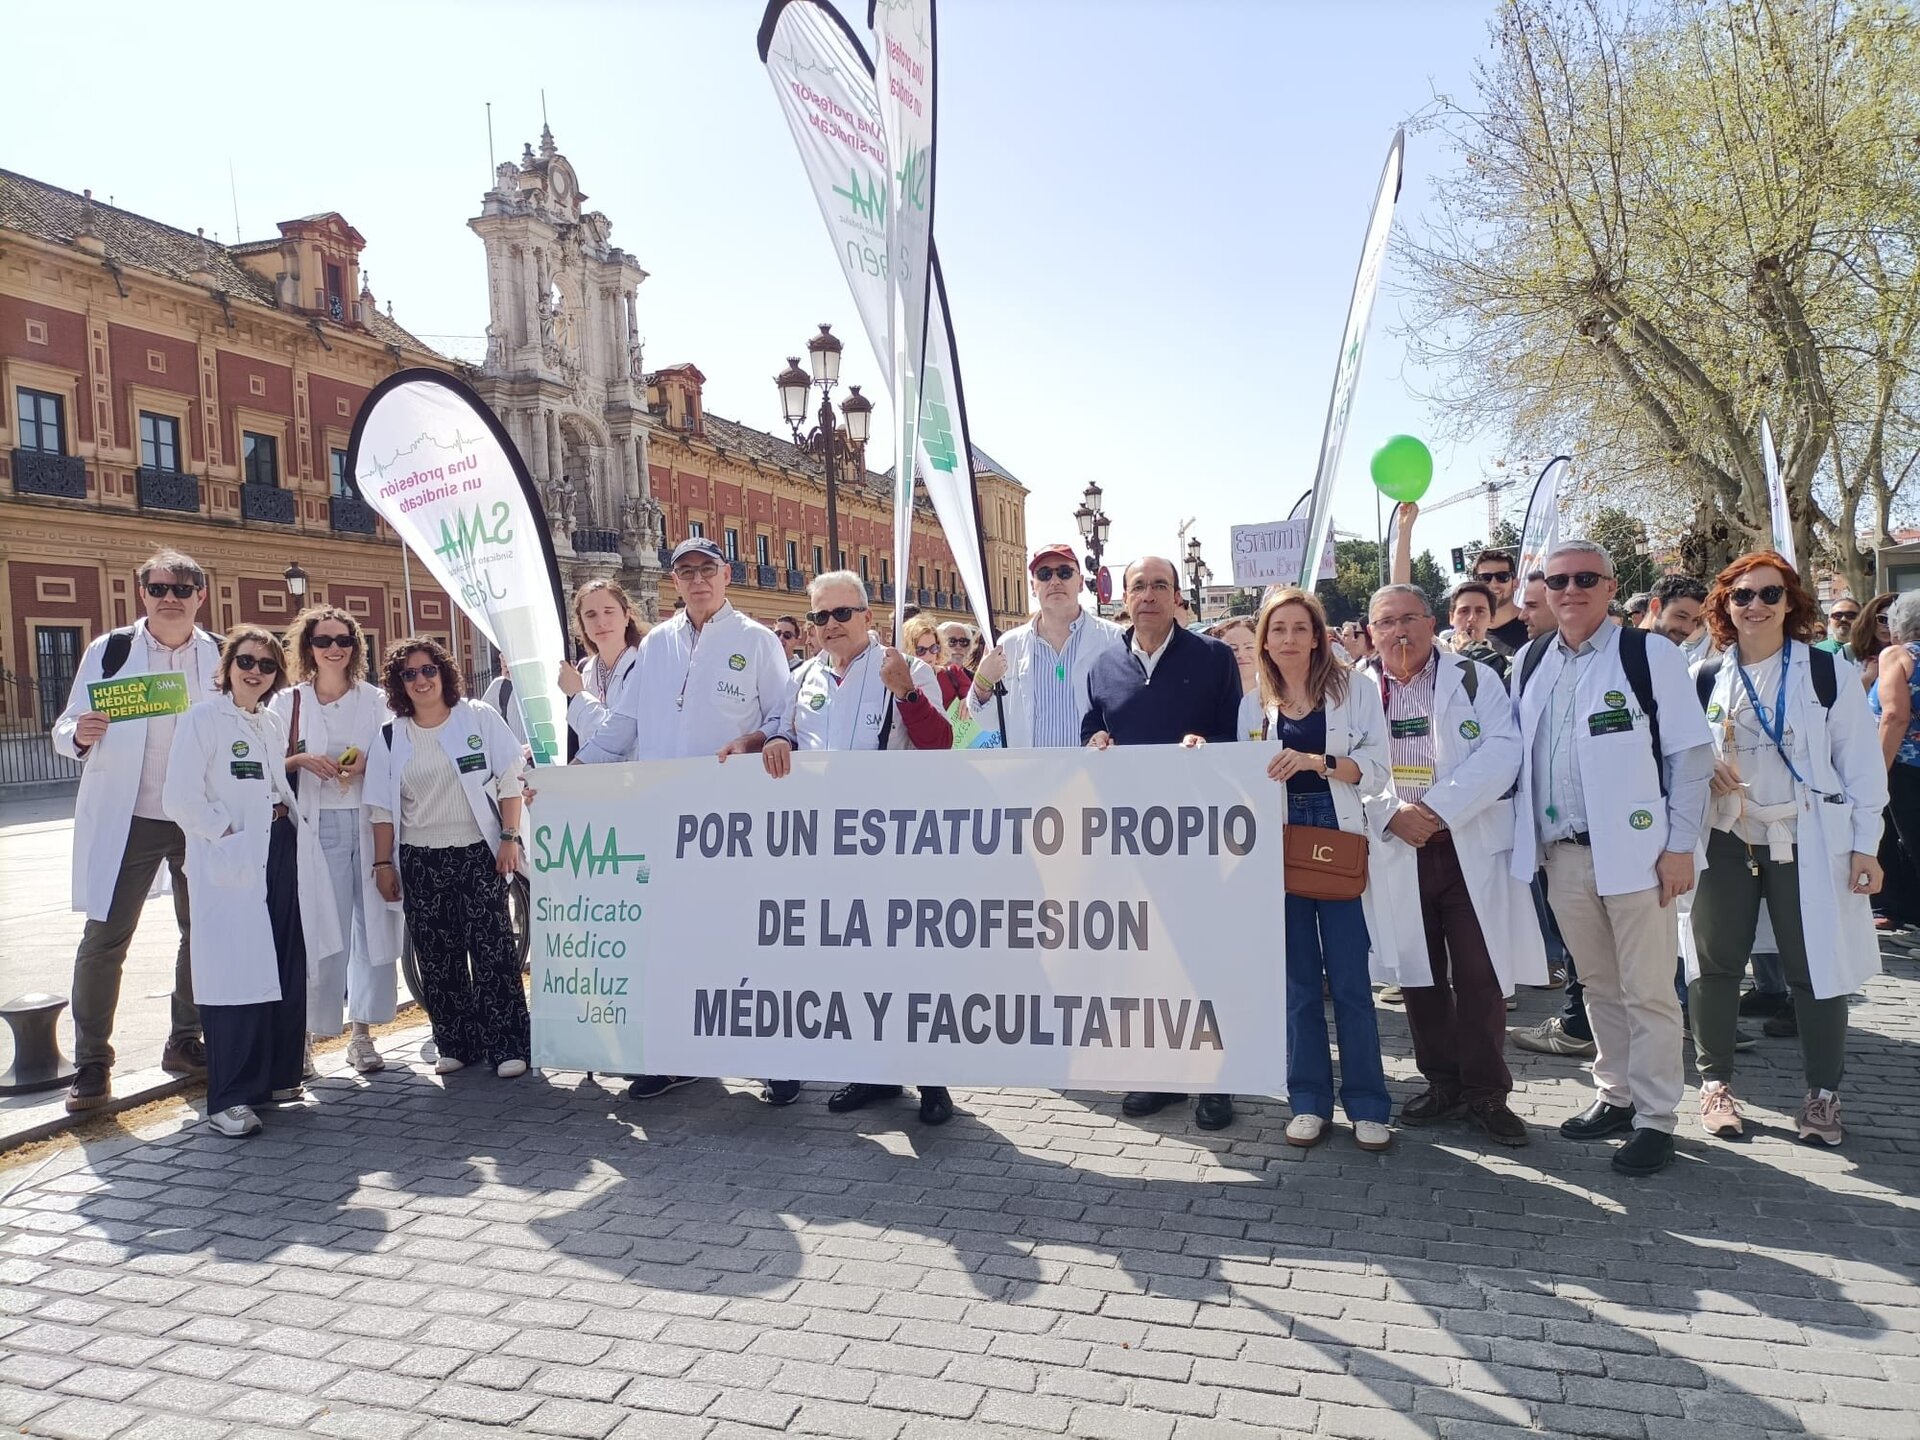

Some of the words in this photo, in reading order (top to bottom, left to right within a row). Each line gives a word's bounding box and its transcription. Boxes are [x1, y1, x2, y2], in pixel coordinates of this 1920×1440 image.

[93, 682, 148, 699] HUELGA
[94, 694, 147, 709] MÉDICA
[716, 680, 747, 697] SMA
[676, 812, 754, 859] POR
[767, 809, 819, 857] UN
[834, 806, 1065, 856] ESTATUTO
[1082, 805, 1257, 857] PROPIO
[534, 821, 646, 880] SMA
[1311, 844, 1334, 863] LC
[536, 895, 642, 922] Sindicato
[758, 899, 806, 947] DE
[820, 899, 873, 948] LA
[887, 898, 1149, 952] PROFESION
[546, 930, 627, 958] Médico
[543, 967, 629, 996] Andaluz
[577, 1000, 626, 1025] Jaén
[693, 977, 853, 1041] MÉDICA
[863, 991, 894, 1042] Y
[907, 993, 1225, 1051] FACULTATIVA
